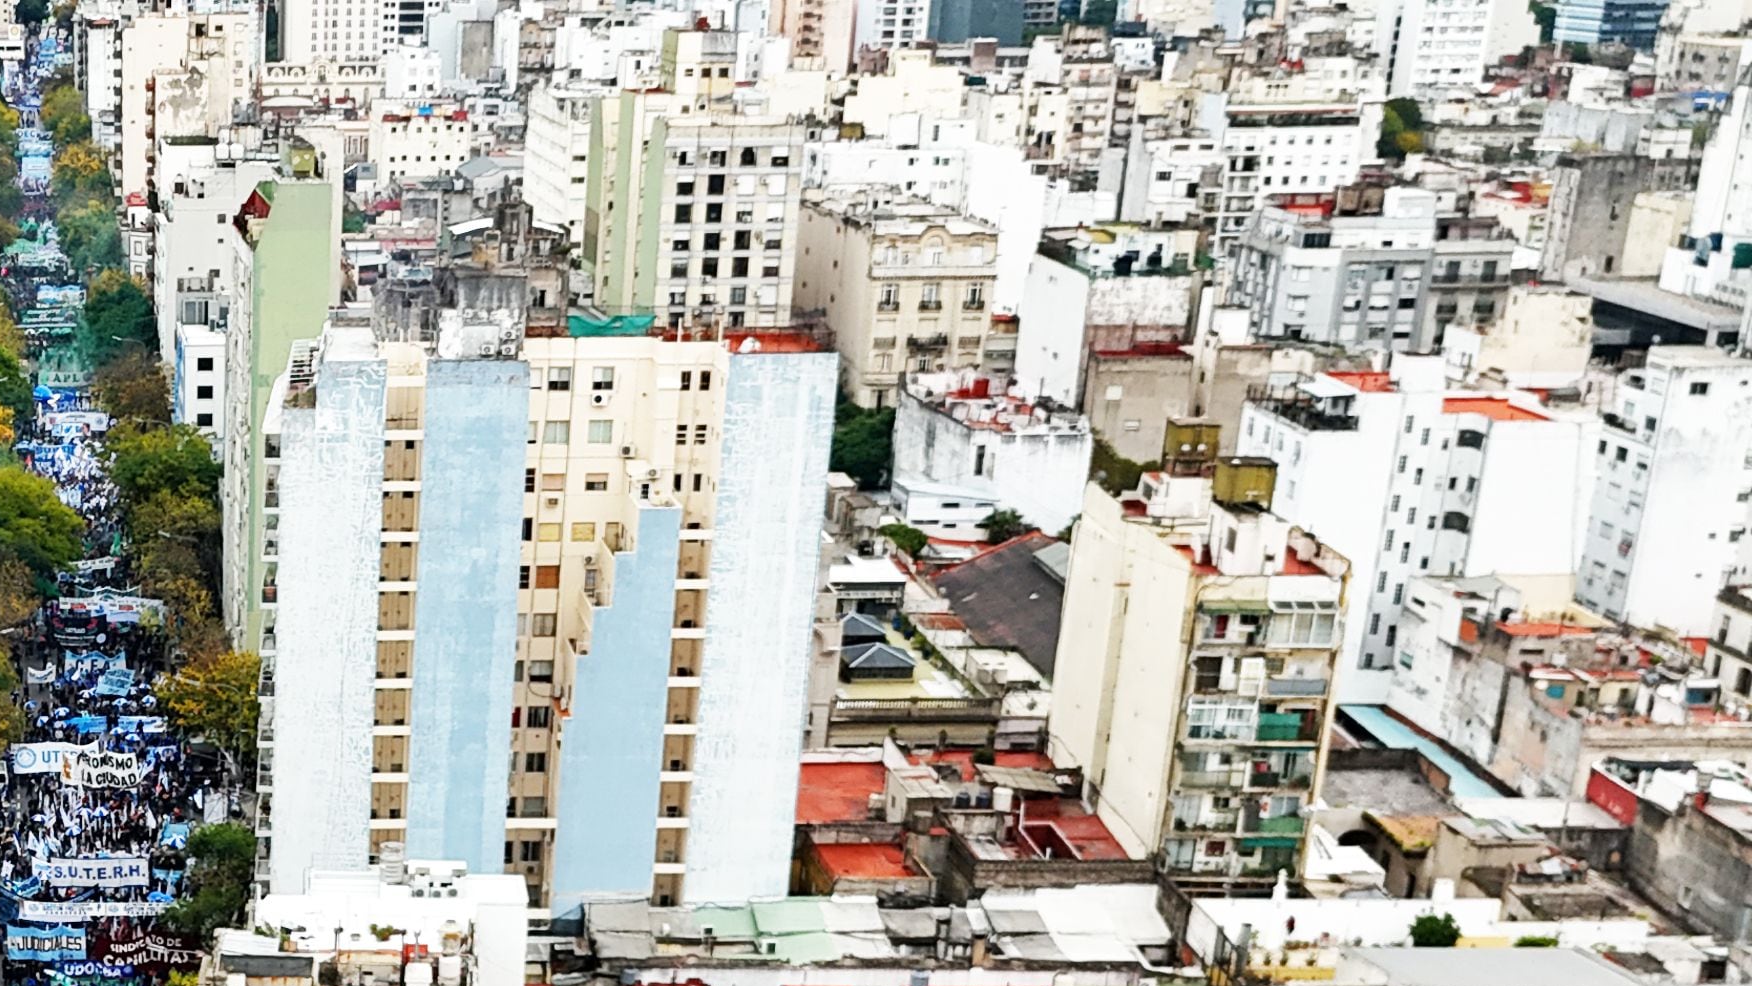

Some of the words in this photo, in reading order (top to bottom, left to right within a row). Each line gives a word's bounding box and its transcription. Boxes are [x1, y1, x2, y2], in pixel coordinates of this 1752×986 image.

[95, 773, 137, 786] CIUDAD
[54, 865, 146, 880] S.U.T.E.R.H.
[166, 937, 182, 947] DE
